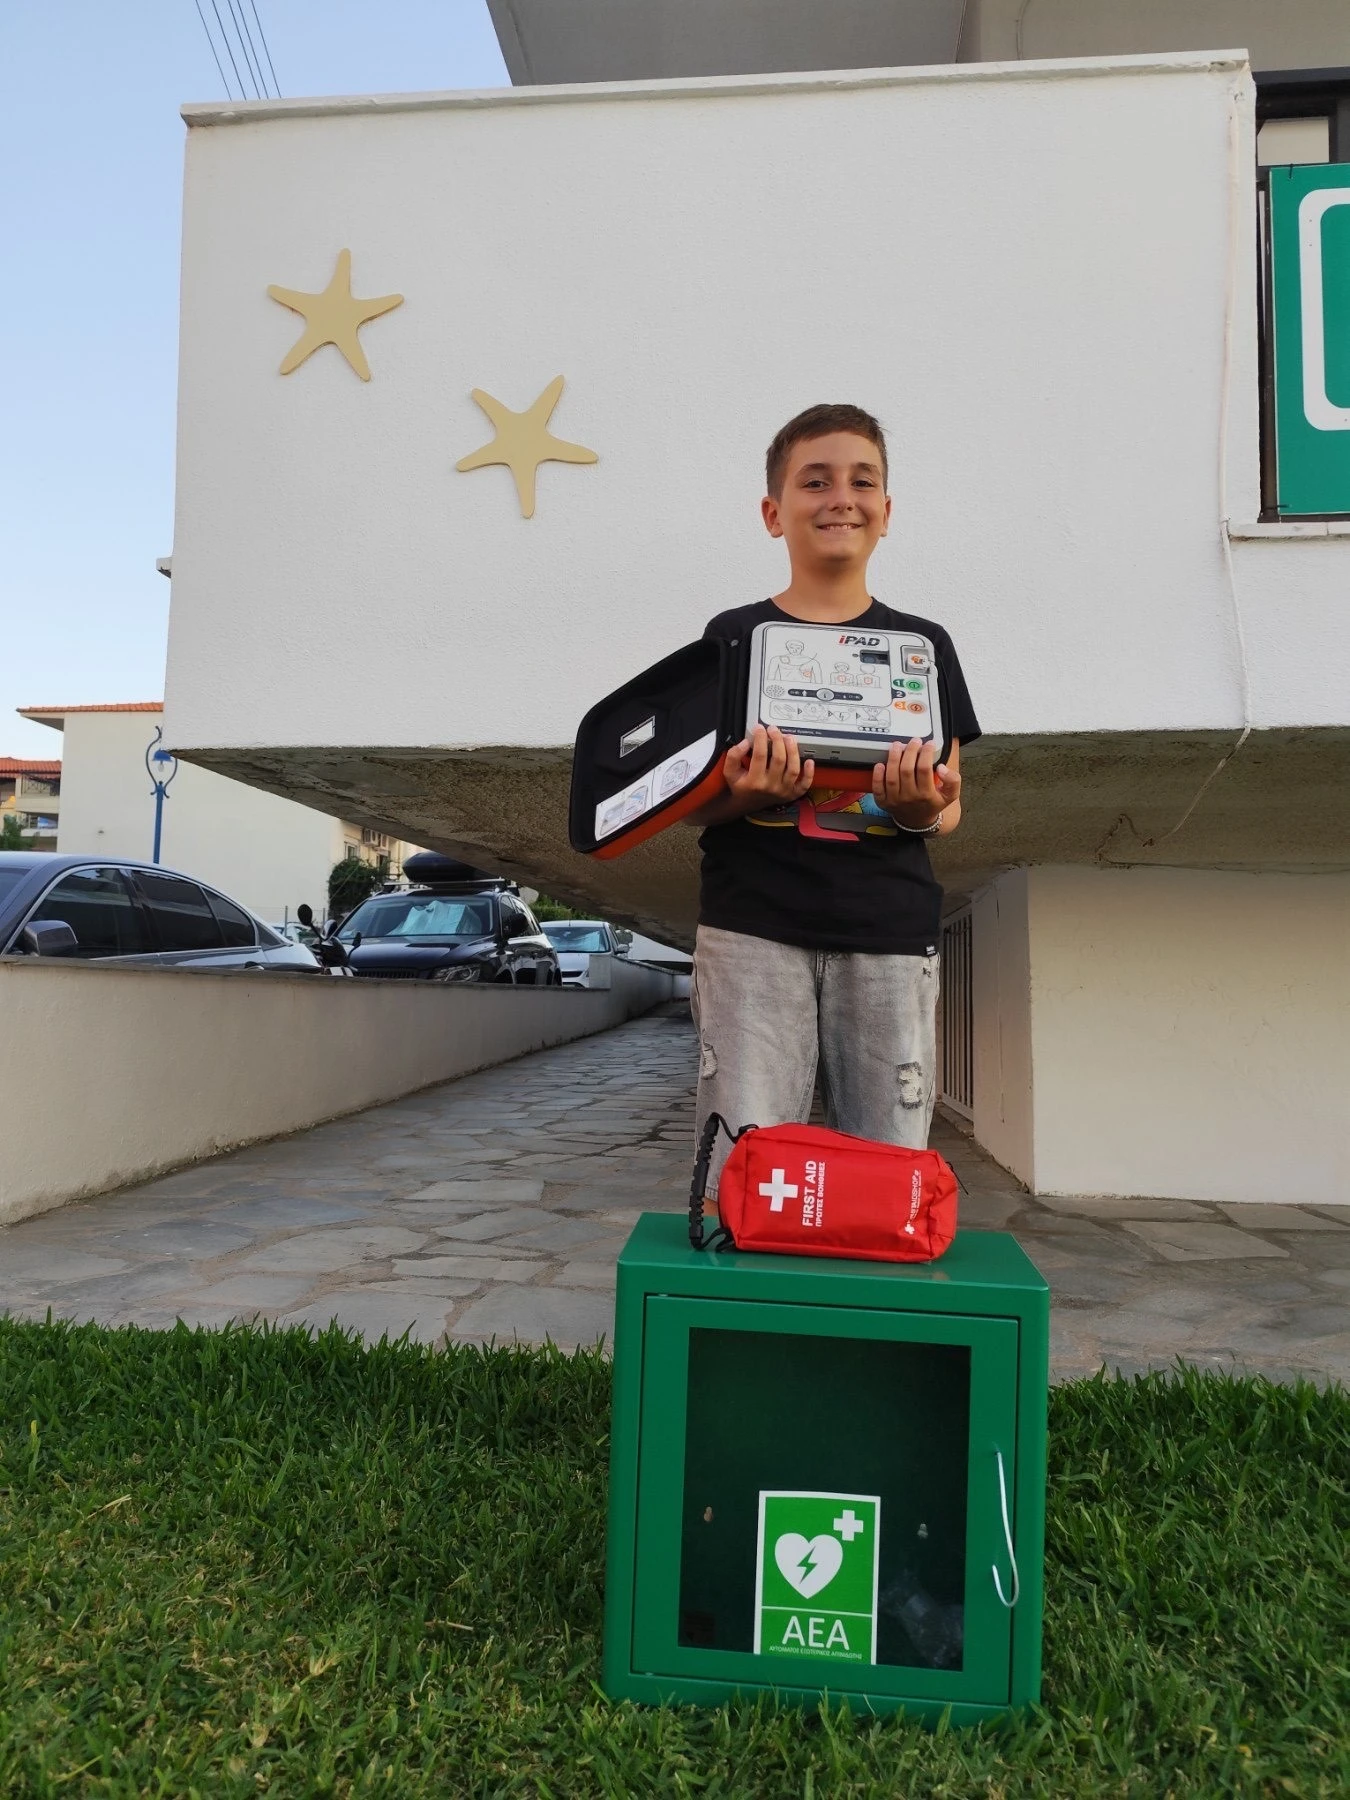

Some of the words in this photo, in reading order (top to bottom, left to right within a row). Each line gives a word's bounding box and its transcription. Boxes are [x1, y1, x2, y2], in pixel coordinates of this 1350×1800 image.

[838, 635, 881, 647] iPAD
[805, 1160, 817, 1184] AID
[817, 1161, 825, 1198] ΒΟΗΘΕΙΕΣ
[802, 1186, 815, 1227] FIRST
[815, 1198, 823, 1227] ΠΡΩΤΕΣ
